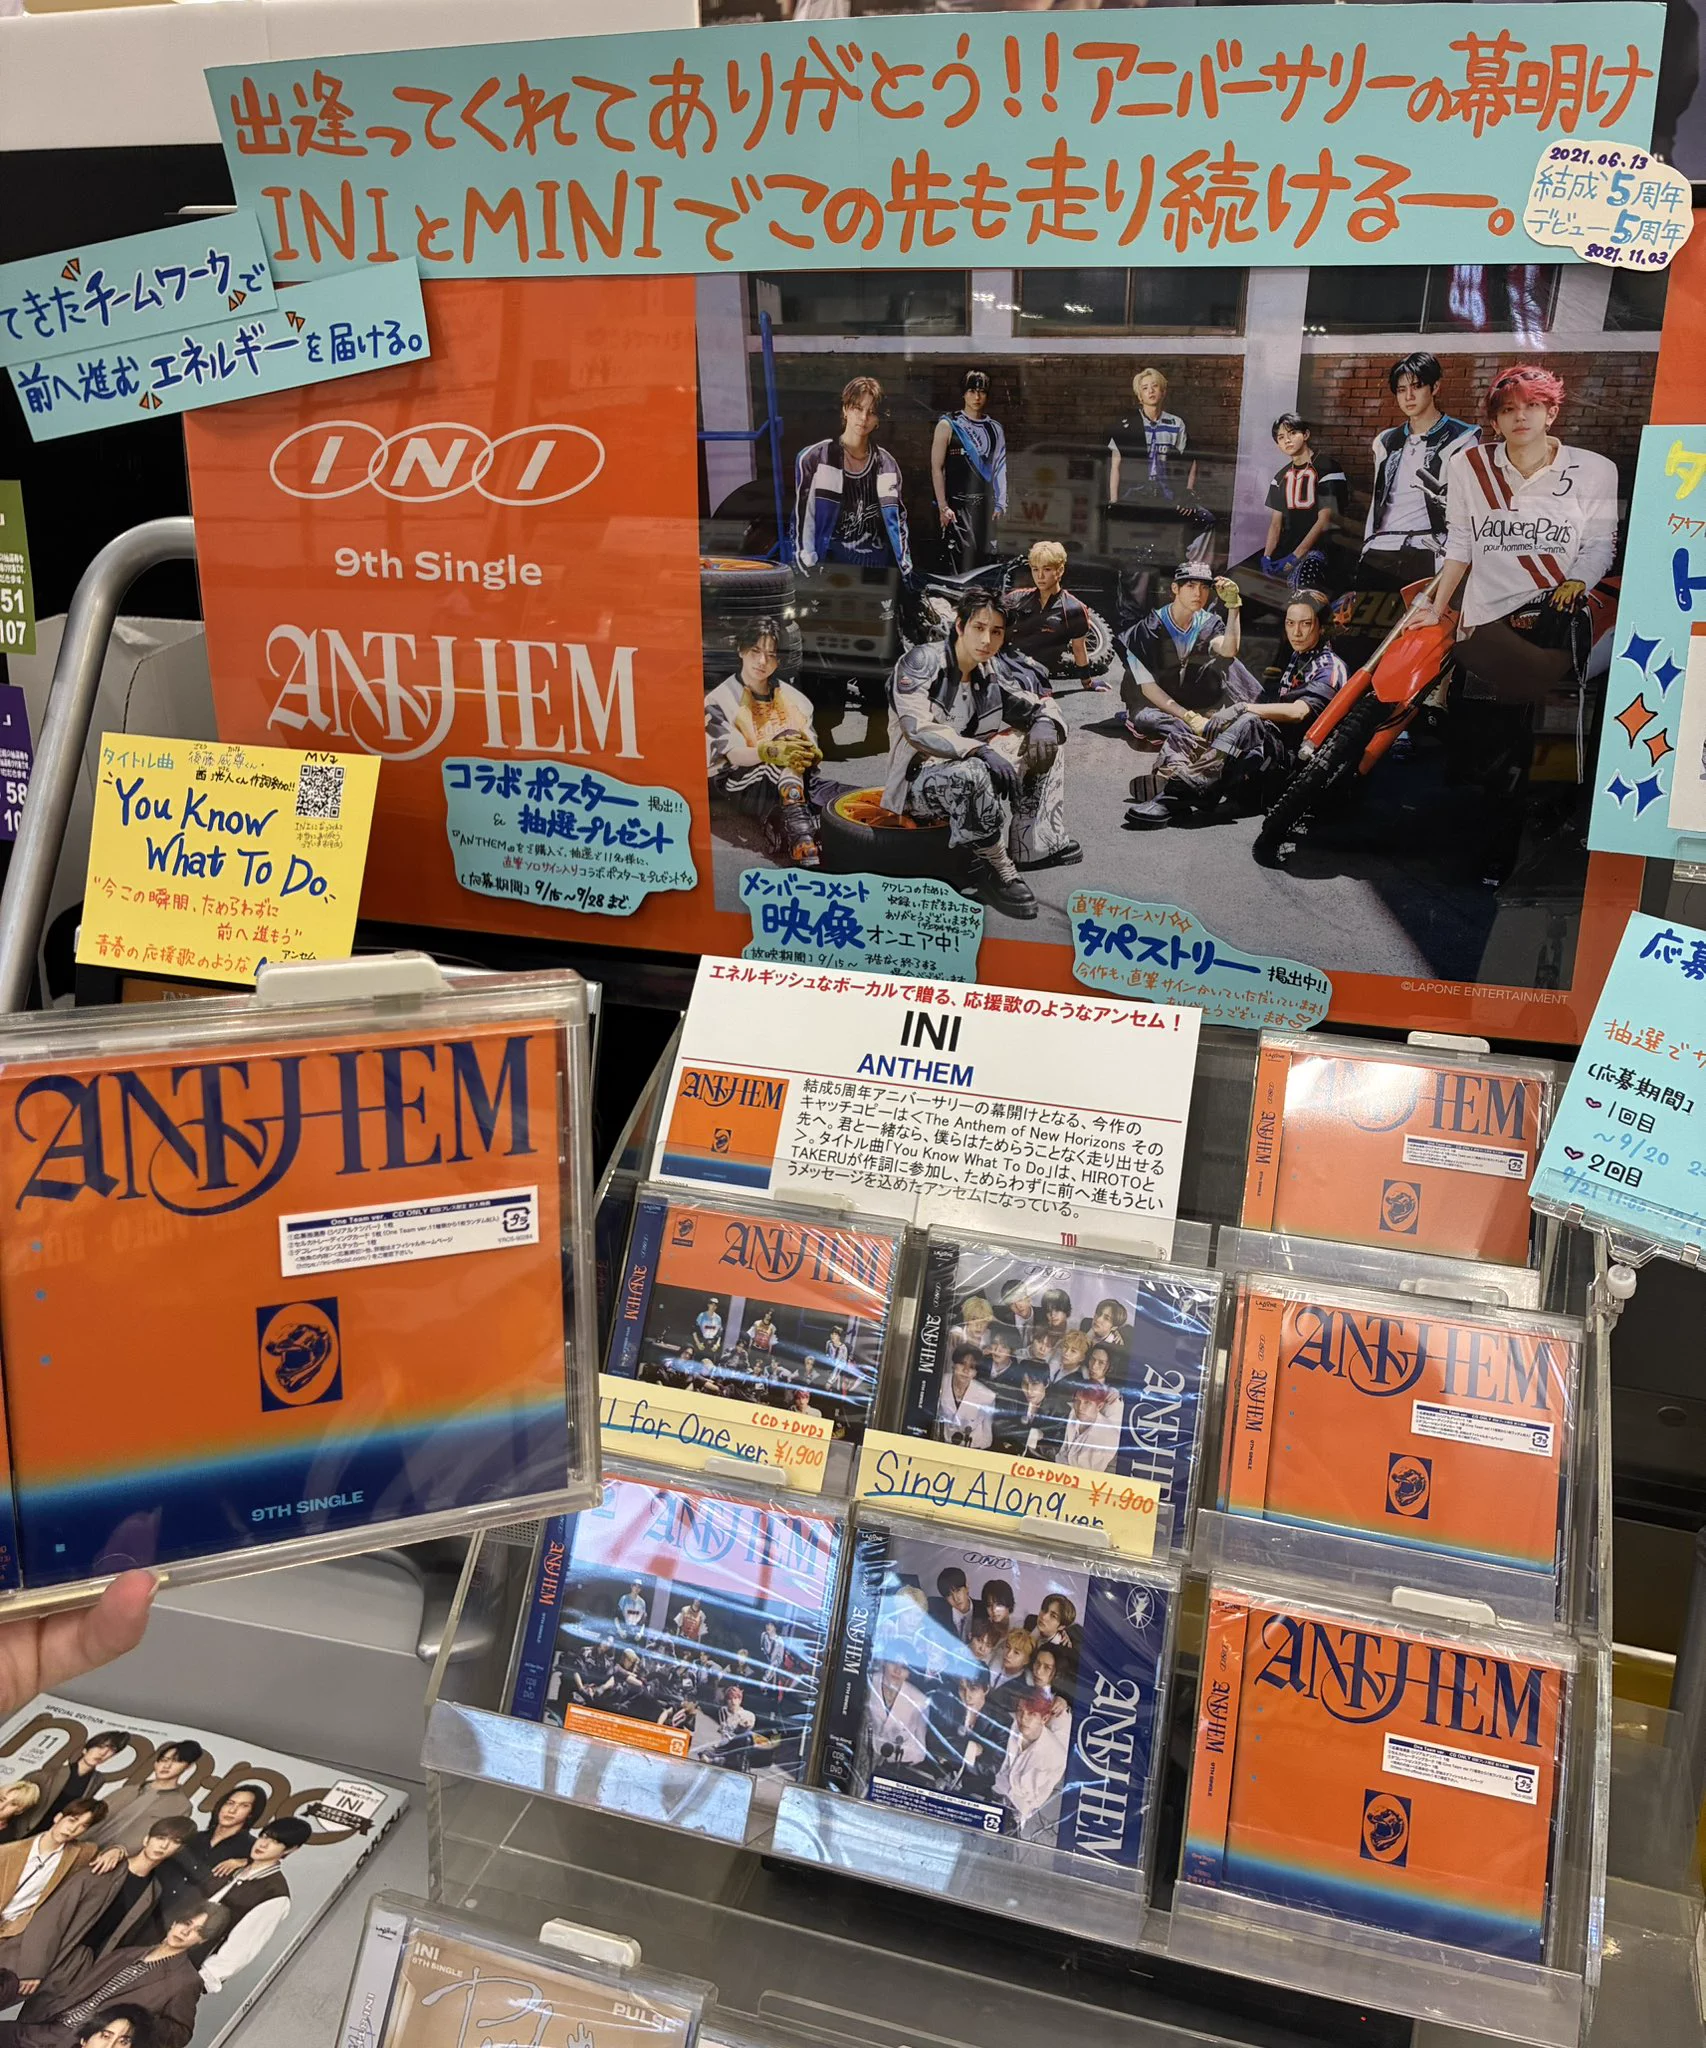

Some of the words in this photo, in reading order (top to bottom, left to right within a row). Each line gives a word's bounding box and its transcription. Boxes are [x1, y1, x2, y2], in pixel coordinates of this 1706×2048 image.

[1549, 147, 1649, 170] 2021.06.13
[1533, 164, 1685, 214] 結成5周年
[1527, 208, 1686, 250] デビュー5周年
[1584, 243, 1668, 265] 2021.11.03
[1284, 468, 1319, 510] 10
[1551, 464, 1580, 497] 5
[334, 547, 403, 579] 9th
[414, 551, 543, 590] Single
[266, 623, 645, 761] ANTHEM
[103, 747, 175, 770] タイトル曲
[116, 777, 172, 826] You
[180, 787, 278, 837] Know
[445, 763, 640, 812] コラボポスター
[517, 804, 675, 854] 抽選プレゼント
[147, 833, 227, 878] What
[237, 849, 273, 887] To
[279, 854, 328, 898] Do
[743, 871, 870, 903] メンバーコメント
[761, 896, 866, 949] 映像
[1071, 893, 1168, 927] 直筆サイン入り
[1077, 918, 1262, 975] タペストリー
[1464, 986, 1569, 1005] ENTERTAINMENT
[899, 1010, 963, 1053] INI
[679, 1071, 786, 1111] ANTHEM
[856, 1053, 975, 1088] ANTHEM
[14, 1034, 538, 1217] ANTHEM
[802, 1077, 1142, 1136] 結成5周年アニバーサリーの幕開けとなる、今作の
[1607, 1100, 1656, 1134] 1回目
[923, 1146, 959, 1164] Know
[963, 1152, 998, 1170] What
[1003, 1157, 1021, 1172] To
[953, 1116, 1006, 1135] Anthem
[1011, 1124, 1026, 1136] of
[1029, 1126, 1060, 1142] New
[1064, 1130, 1126, 1152] Horizons
[1131, 1139, 1164, 1156] その
[787, 1160, 1080, 1220] うメッセージを込めたアンセムになっている。
[791, 1145, 1164, 1211] TAKERUが作詞に参加し、ためらわずに前へ進もうとい
[1587, 1154, 1644, 1189] 2回目
[917, 1312, 942, 1375] ANTHEM
[1287, 1305, 1555, 1411] ANTHEM
[1244, 1366, 1268, 1433] ANTHEM
[630, 1400, 672, 1440] for
[678, 1412, 731, 1450] One
[251, 1504, 292, 1524] 9TH
[295, 1489, 365, 1516] SINGLE
[873, 1449, 956, 1508] Sing
[962, 1471, 1066, 1521] Along
[842, 1606, 868, 1676] ANTHEM
[1253, 1613, 1548, 1749] ANTHEM
[1205, 1678, 1231, 1755] ANTHEM
[335, 1795, 365, 1813] INI
[413, 1941, 440, 1961] INI
